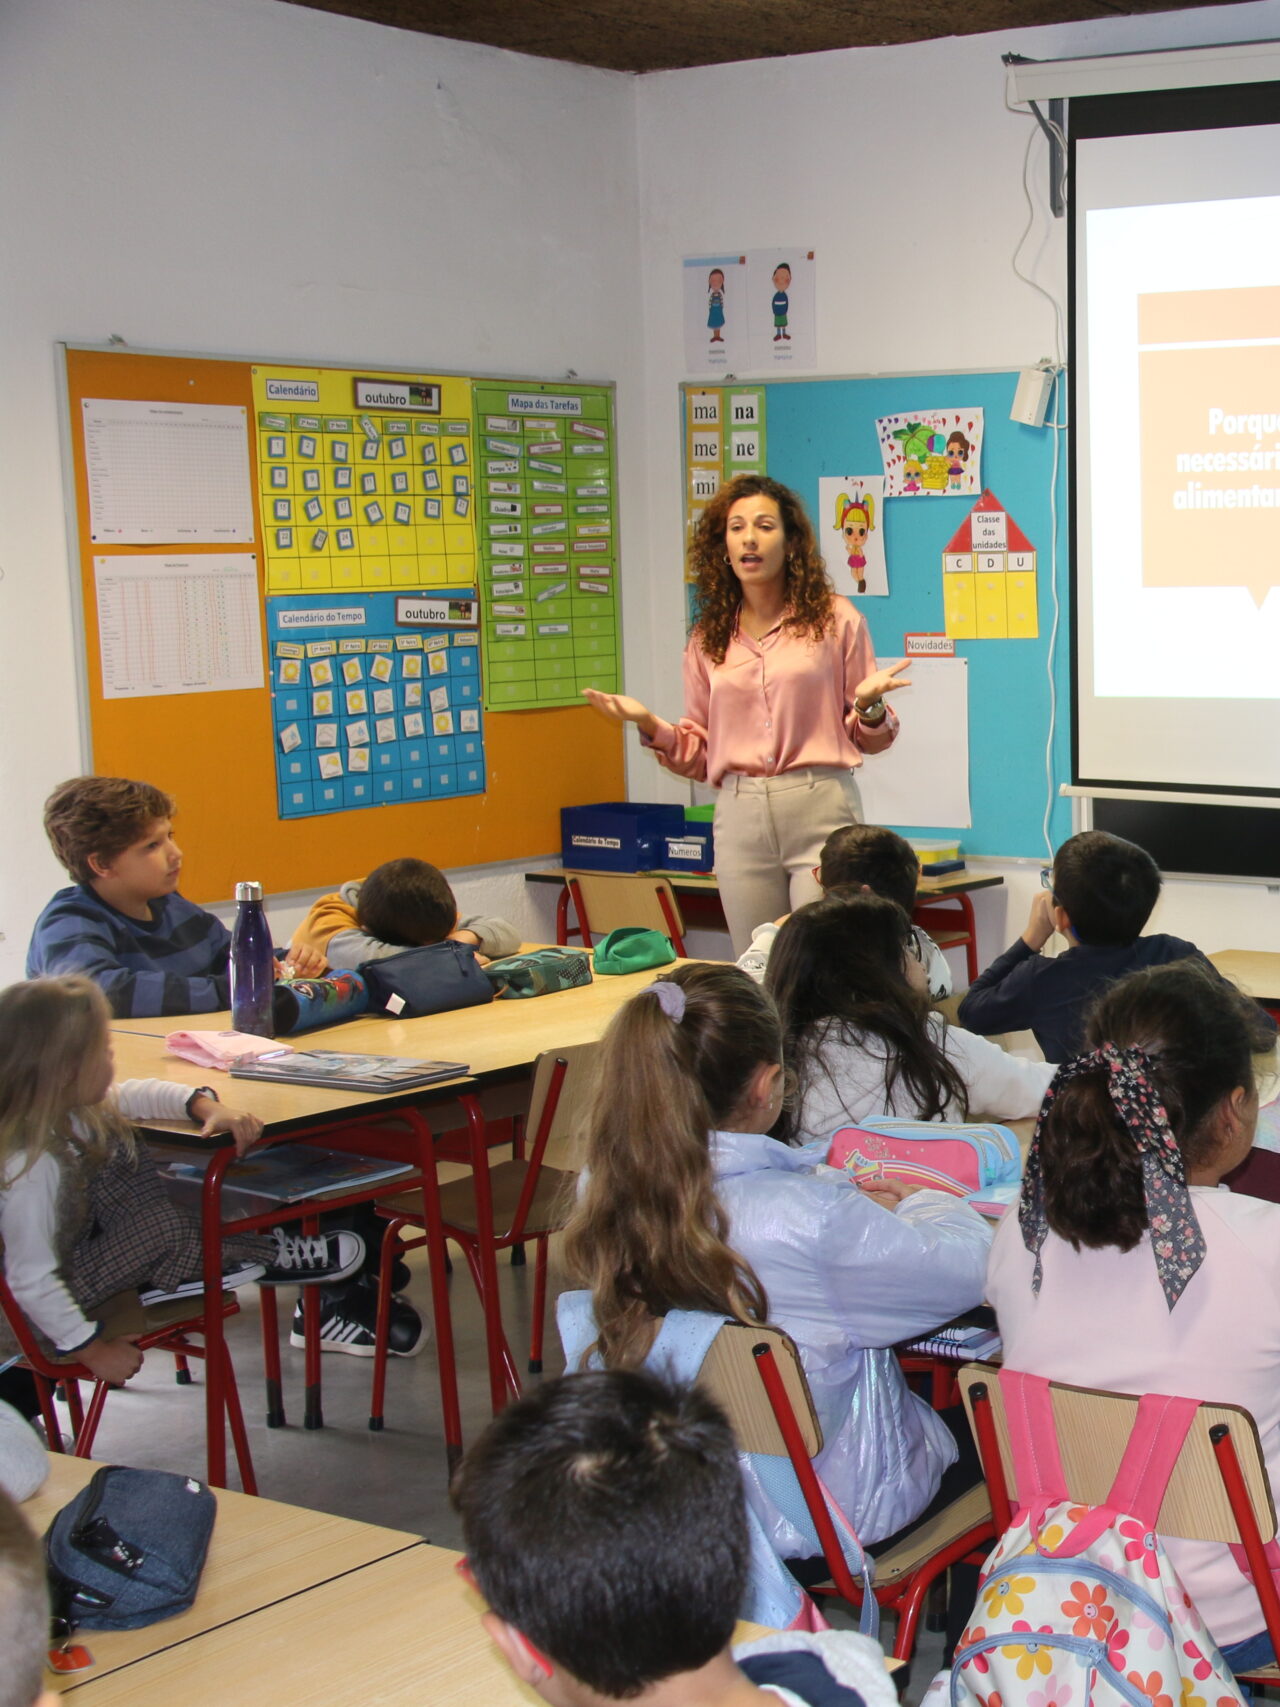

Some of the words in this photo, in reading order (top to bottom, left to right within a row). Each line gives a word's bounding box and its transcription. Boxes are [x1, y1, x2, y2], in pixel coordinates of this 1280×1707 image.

[268, 384, 317, 397] Calendário
[365, 392, 407, 406] outubro
[511, 398, 536, 411] Mapa
[537, 400, 549, 410] das
[550, 400, 579, 412] Tarefas
[694, 407, 717, 419] ma
[735, 406, 755, 419] na
[694, 444, 718, 456] me
[736, 443, 755, 456] ne
[696, 476, 716, 495] mi
[977, 515, 1000, 523] Classe
[982, 528, 995, 536] das
[973, 541, 1006, 549] unidades
[956, 558, 962, 568] C
[987, 558, 994, 568] D
[1017, 557, 1024, 567] U
[282, 612, 325, 624] Calendário
[326, 612, 335, 622] do
[336, 611, 363, 624] Tempo
[405, 607, 446, 620] outubro
[907, 638, 954, 652] Novidades
